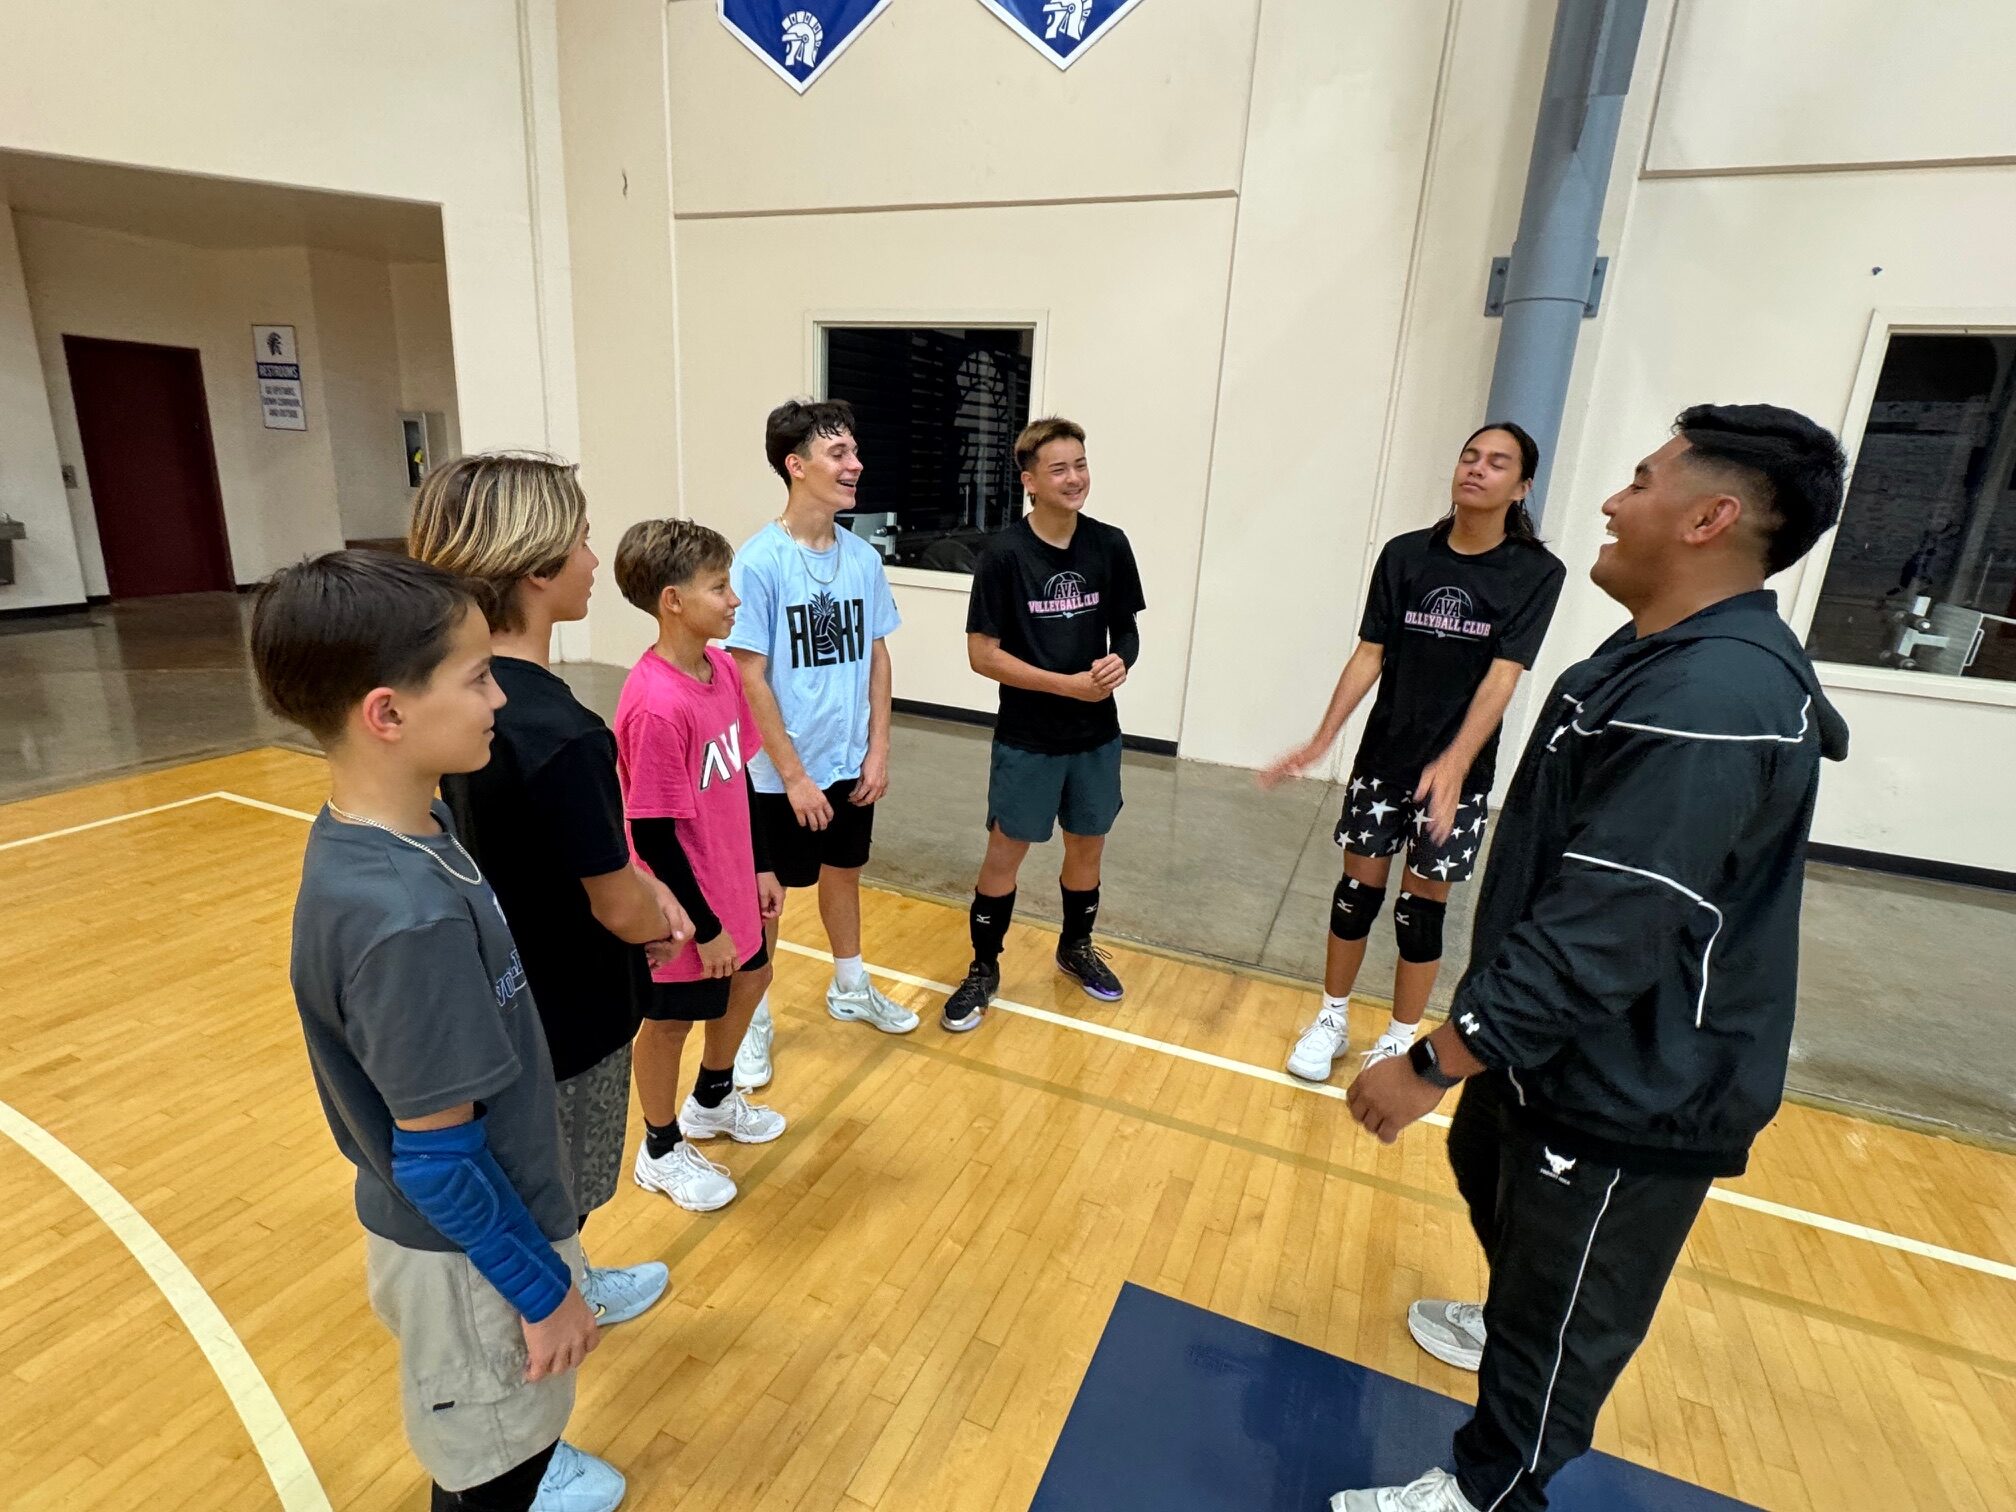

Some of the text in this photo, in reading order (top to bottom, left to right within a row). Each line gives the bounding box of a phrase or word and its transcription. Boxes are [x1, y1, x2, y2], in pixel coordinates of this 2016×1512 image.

[1054, 581, 1081, 599] AVA
[1027, 591, 1100, 614] VOLLEYBALL CLU
[1431, 597, 1461, 618] AVA
[1404, 610, 1491, 636] OLLEYBALL CLUB
